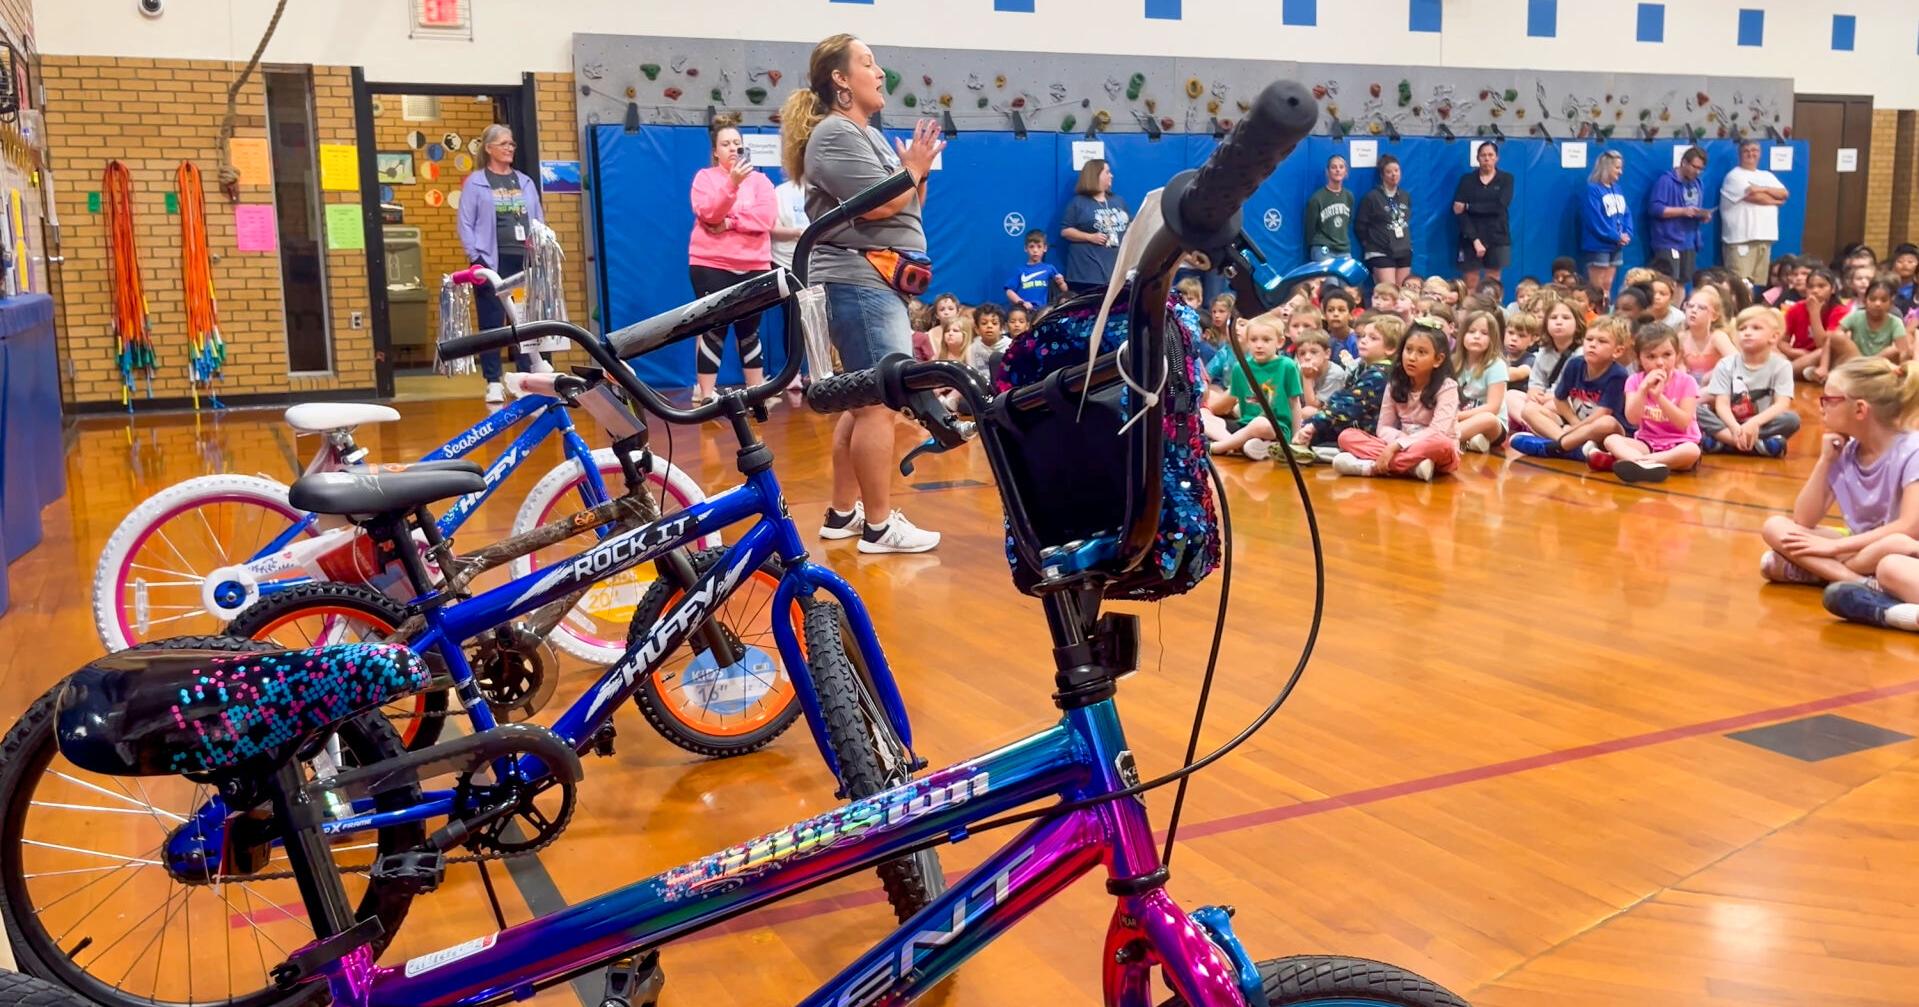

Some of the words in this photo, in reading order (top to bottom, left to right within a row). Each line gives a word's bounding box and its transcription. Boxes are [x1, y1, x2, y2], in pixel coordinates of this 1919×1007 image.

[443, 421, 494, 459] Seastar
[573, 536, 647, 582] ROCK
[657, 515, 690, 544] IT
[621, 575, 716, 687] HUFFY
[691, 668, 725, 681] KIDS
[821, 845, 1036, 1007] ENT
